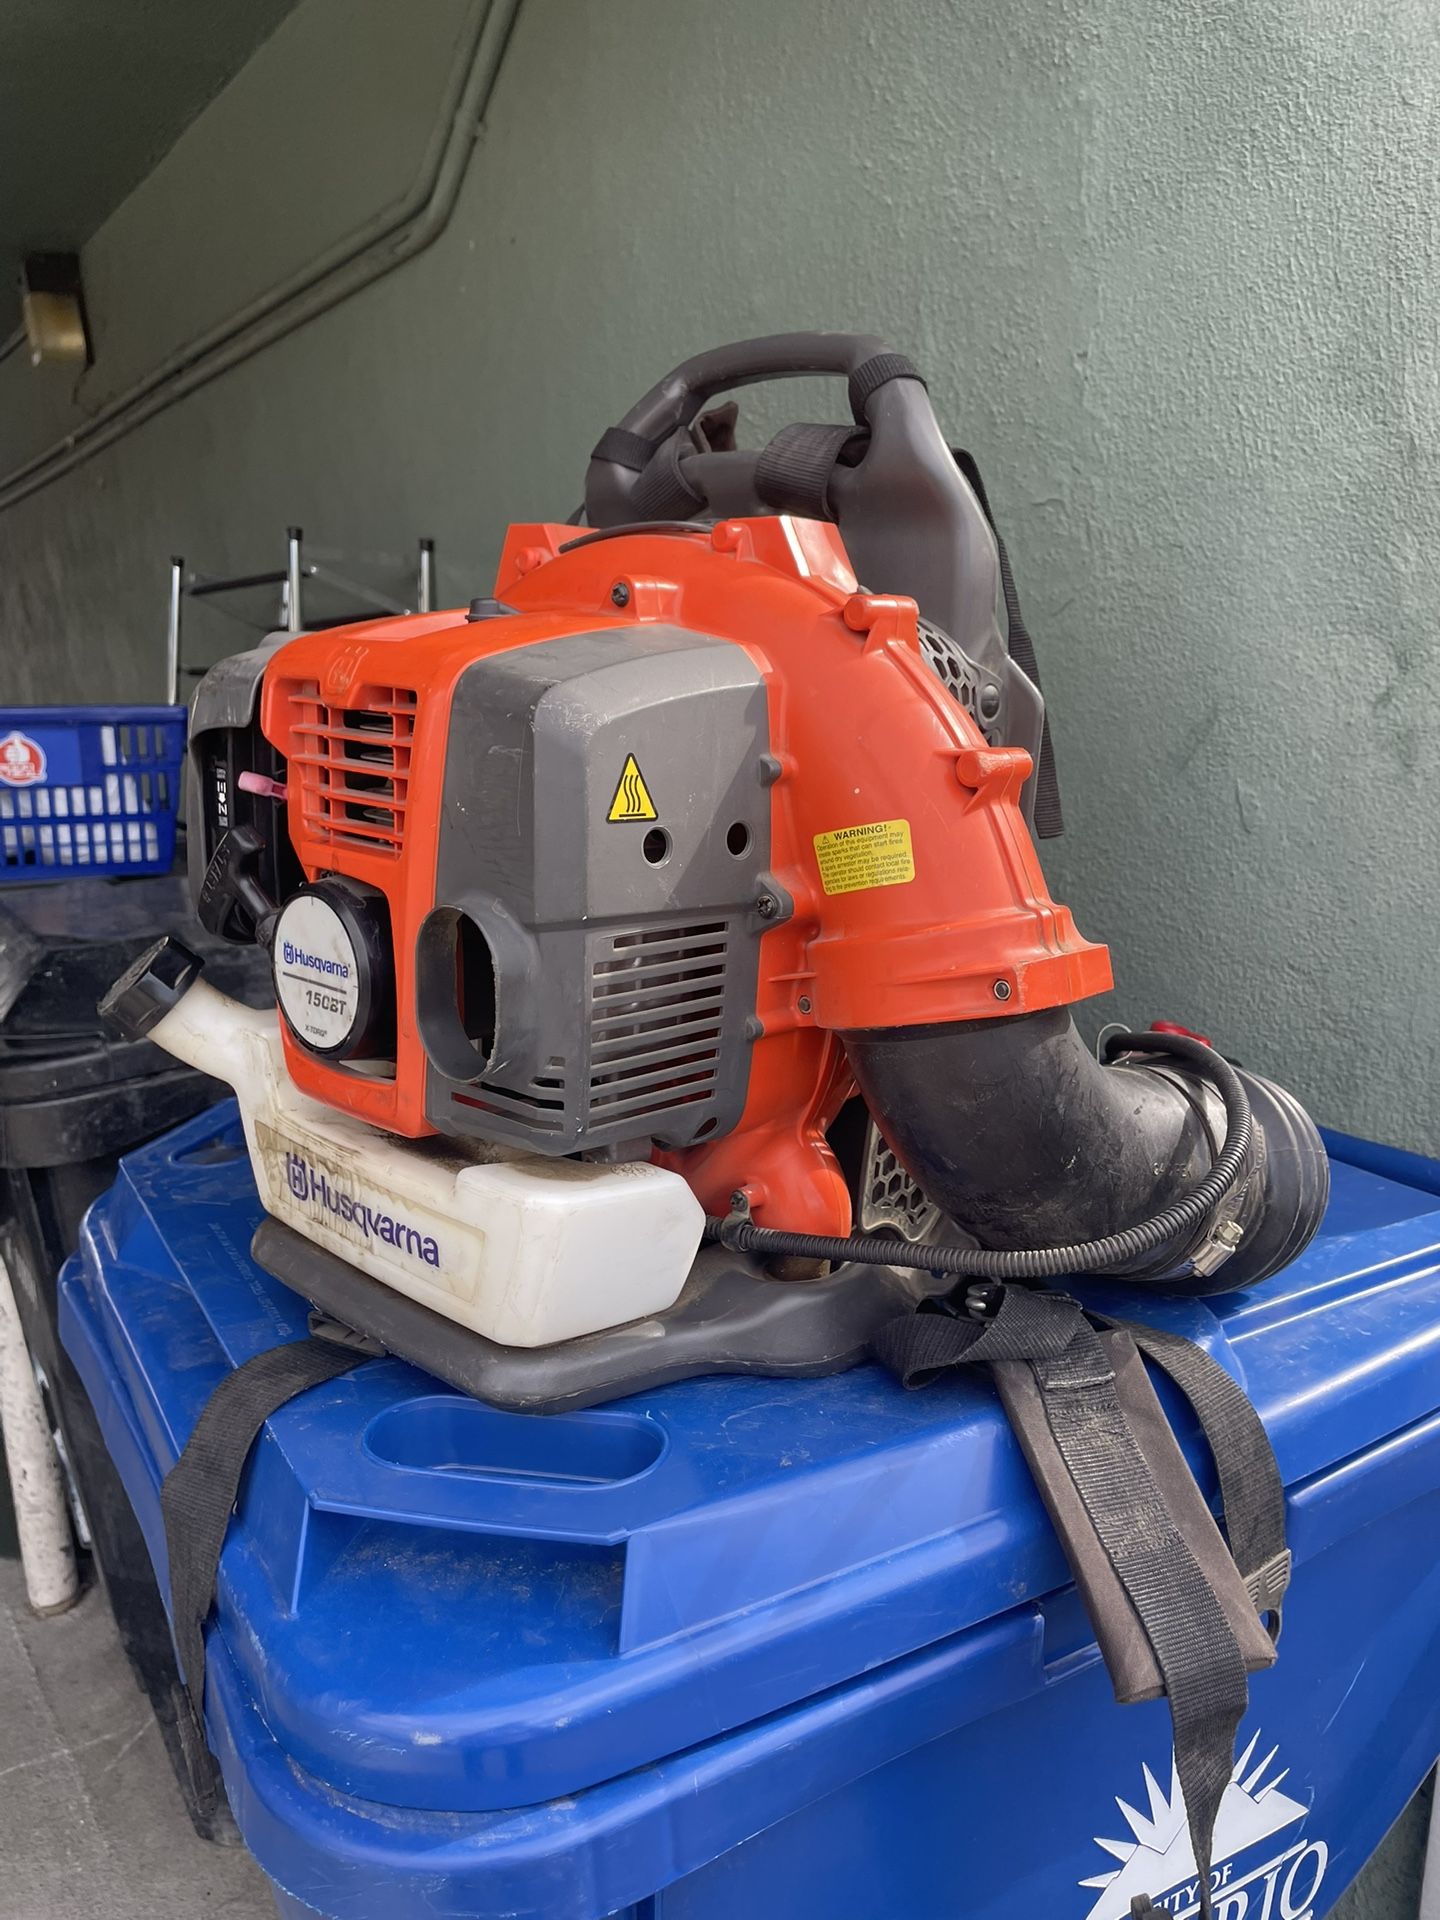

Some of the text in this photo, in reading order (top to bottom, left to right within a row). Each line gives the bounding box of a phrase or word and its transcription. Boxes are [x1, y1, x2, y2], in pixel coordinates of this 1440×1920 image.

[834, 824, 887, 840] WARNING!
[817, 842, 839, 852] Operation
[857, 832, 888, 844] equipment
[874, 840, 887, 848] start
[848, 865, 864, 873] should
[865, 862, 885, 871] contact
[294, 947, 349, 978] Husqvarna
[309, 1169, 410, 1268] Husqvarna
